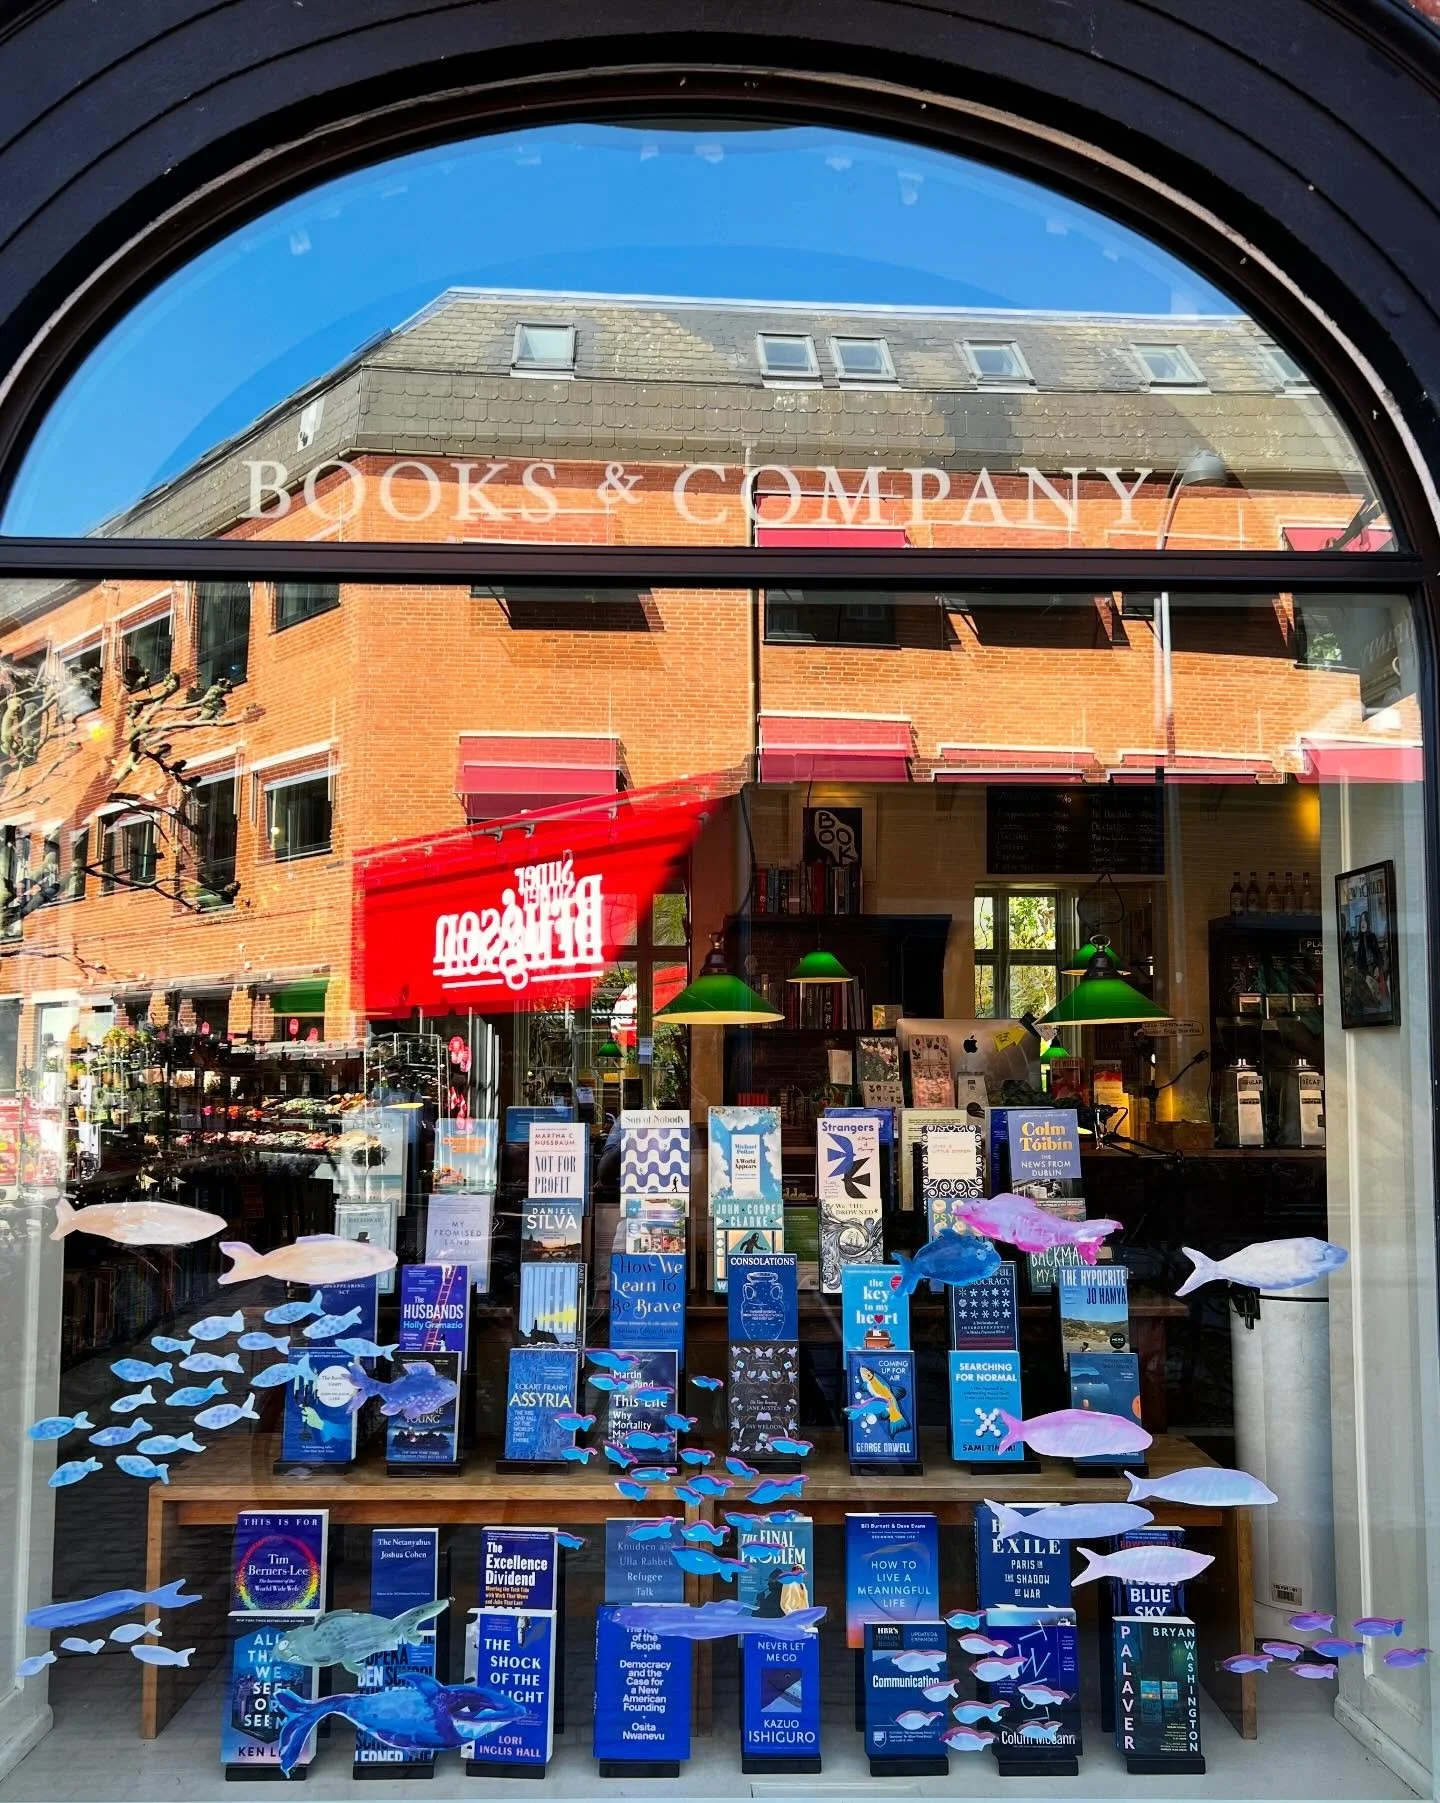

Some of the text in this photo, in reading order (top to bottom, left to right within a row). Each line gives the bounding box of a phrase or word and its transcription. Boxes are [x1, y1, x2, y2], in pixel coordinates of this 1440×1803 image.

[244, 459, 1154, 530] BOOKS & COMPANY
[822, 1121, 875, 1134] Strangers
[1021, 1121, 1066, 1137] Colm
[1019, 1136, 1073, 1152] Tóibín
[534, 1155, 577, 1174] NOT FOR
[1021, 1160, 1071, 1169] NEWS FROM
[1031, 1169, 1062, 1177] DUBLIN
[534, 1176, 570, 1195] PROFIT
[532, 1207, 573, 1216] DANIEL
[716, 1203, 783, 1215] JOHN COOPER
[526, 1215, 578, 1230] SILVA
[730, 1215, 768, 1228] CLARKE
[433, 1229, 482, 1237] PROMISED
[615, 1254, 683, 1275] How We
[730, 1257, 795, 1266] CONSOLATIONS
[1036, 1269, 1049, 1283] MY
[1062, 1269, 1078, 1287] THE
[1081, 1269, 1126, 1287] HYPOCRITE
[612, 1271, 680, 1298] Learn To
[869, 1278, 884, 1288] the
[414, 1295, 425, 1304] The
[863, 1287, 890, 1301] key
[1087, 1287, 1127, 1305] JO HAMYA
[403, 1303, 464, 1320] HUSBANDS
[635, 1298, 682, 1320] Brave
[864, 1303, 889, 1313] to my
[403, 1320, 463, 1331] Holly Gramazio
[878, 1360, 909, 1368] COMING
[959, 1362, 1013, 1372] SEARCHING
[613, 1370, 642, 1379] Martin
[892, 1367, 906, 1375] FOR
[955, 1373, 1018, 1382] FOR NORMAL
[543, 1383, 568, 1391] FRAHM
[508, 1391, 573, 1408] ASSYRIA
[613, 1394, 639, 1408] This
[612, 1410, 632, 1420] Why
[612, 1420, 652, 1431] Mortality
[855, 1442, 911, 1453] GEORGE ORWELL
[962, 1443, 985, 1452] SAMI
[243, 1518, 319, 1527] THIS IS FOR
[378, 1538, 431, 1548] The Netanyahus
[760, 1529, 796, 1548] FINAL
[486, 1541, 503, 1553] The
[617, 1542, 656, 1551] Knudsen
[991, 1538, 1061, 1555] EXILE
[267, 1553, 289, 1565] Tim
[380, 1551, 427, 1560] Joshua Cohen
[485, 1554, 548, 1571] Excellence
[619, 1557, 637, 1566] Ulla
[871, 1560, 917, 1570] HOW TO
[1011, 1559, 1035, 1570] PARIS
[248, 1564, 309, 1576] Berners-Lee
[485, 1569, 536, 1587] Dividend
[627, 1571, 663, 1583] Refugee
[876, 1574, 912, 1583] LIVE A
[1016, 1573, 1050, 1585] SHADOW
[635, 1587, 654, 1597] Talk
[857, 1585, 931, 1596] MEANINGFUL
[1023, 1588, 1041, 1599] WAR
[1130, 1588, 1171, 1603] BLUE
[883, 1599, 906, 1609] LIFE
[1134, 1606, 1167, 1617] SKY
[877, 1627, 899, 1635] HBR's
[1152, 1627, 1195, 1638] BRYAN
[632, 1633, 659, 1642] of the
[484, 1638, 511, 1652] THE
[630, 1641, 662, 1652] People
[757, 1641, 806, 1651] NEVER LET
[490, 1655, 542, 1670] SHOCK
[766, 1653, 797, 1662] ME GO
[619, 1660, 672, 1671] Democracy
[255, 1666, 282, 1679] WE
[628, 1668, 662, 1678] and the
[490, 1672, 541, 1687] OF THE
[625, 1677, 664, 1687] Case for
[872, 1674, 940, 1688] Communication
[630, 1686, 659, 1695] a New
[1120, 1625, 1136, 1750] PALAVER
[622, 1694, 667, 1704] American
[1183, 1640, 1199, 1752] WASHINGTON
[254, 1697, 280, 1713] OR
[623, 1703, 666, 1714] Founding
[631, 1722, 657, 1732] Osita
[763, 1719, 800, 1729] KAZUO
[498, 1735, 523, 1745] LORI
[622, 1731, 665, 1741] Nwanevu
[748, 1730, 816, 1744] ISHIGURO
[238, 1746, 265, 1757] KEN
[479, 1745, 542, 1758] INGLIS HALL
